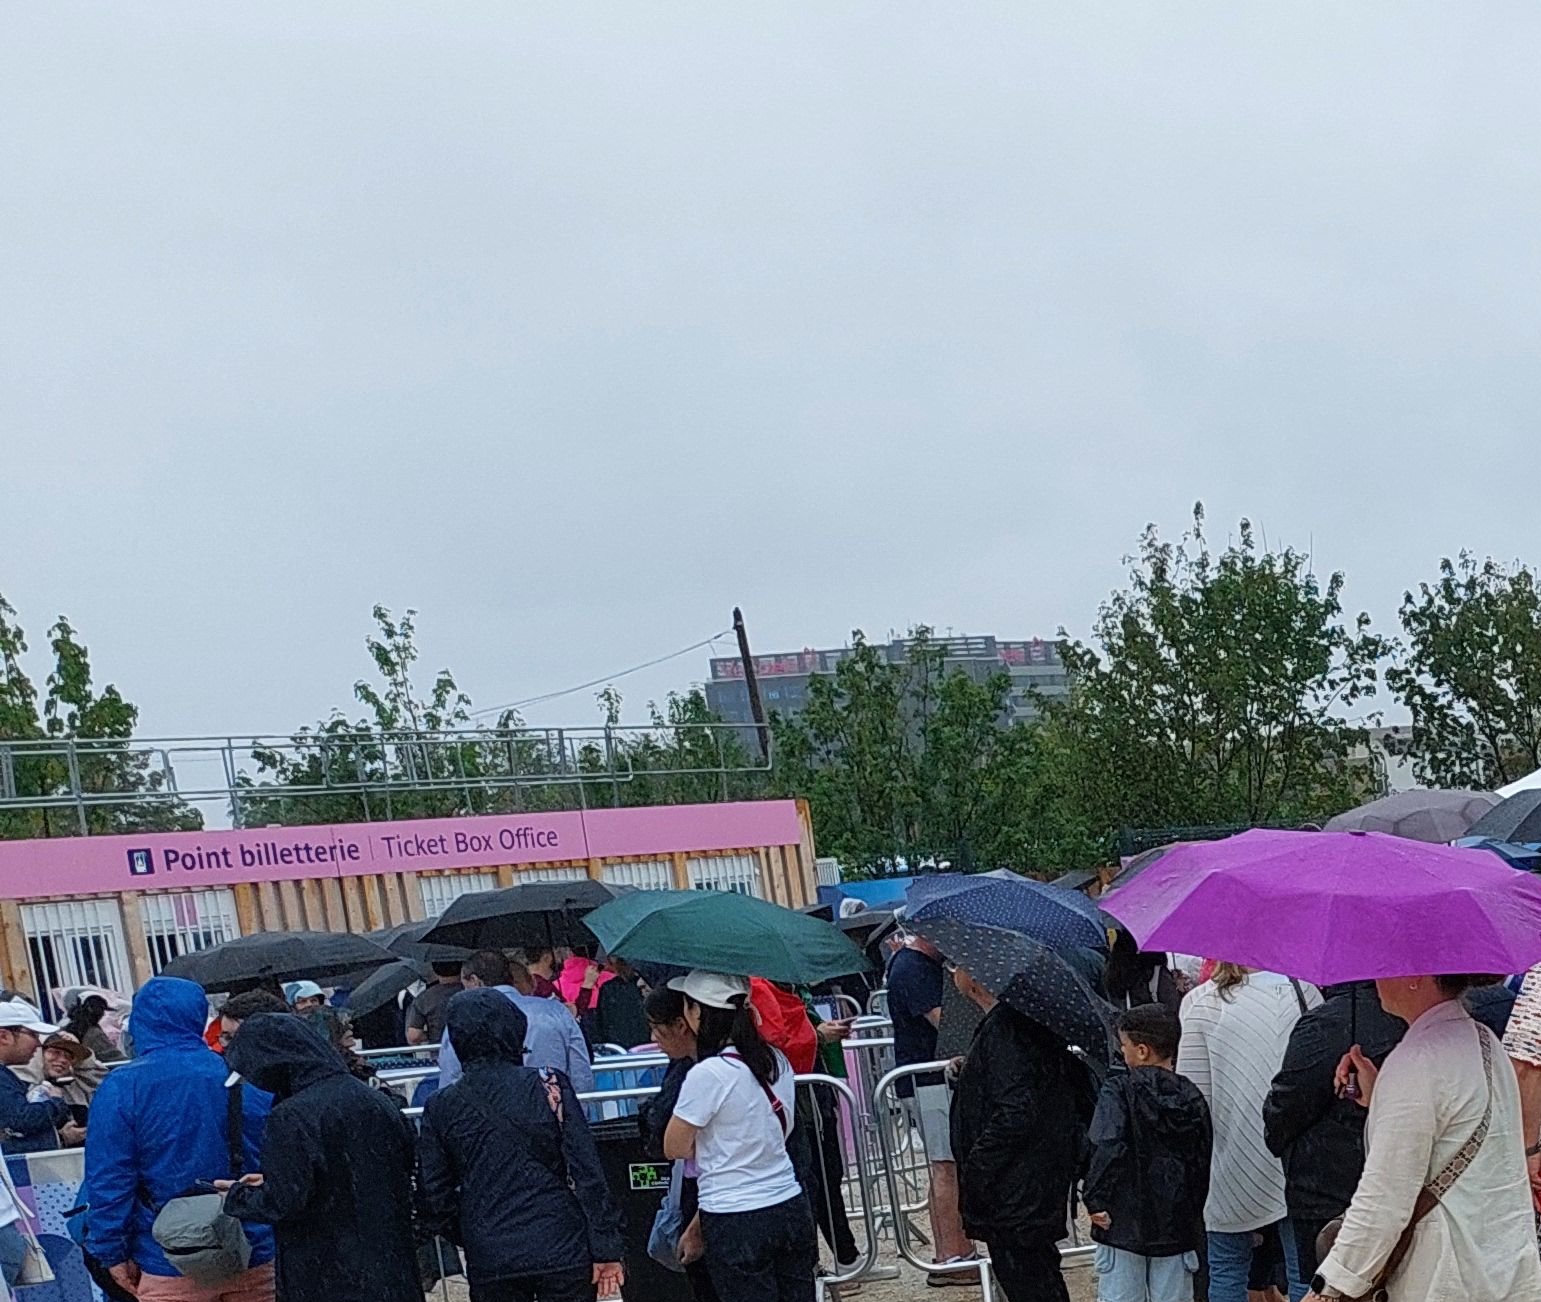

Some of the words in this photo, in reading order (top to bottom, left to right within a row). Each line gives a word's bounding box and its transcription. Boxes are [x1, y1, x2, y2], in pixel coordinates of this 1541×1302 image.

[163, 847, 232, 873] Point
[240, 837, 362, 869] billetterie
[381, 833, 449, 860] Ticket
[455, 830, 495, 854] Box
[498, 826, 560, 851] Office
